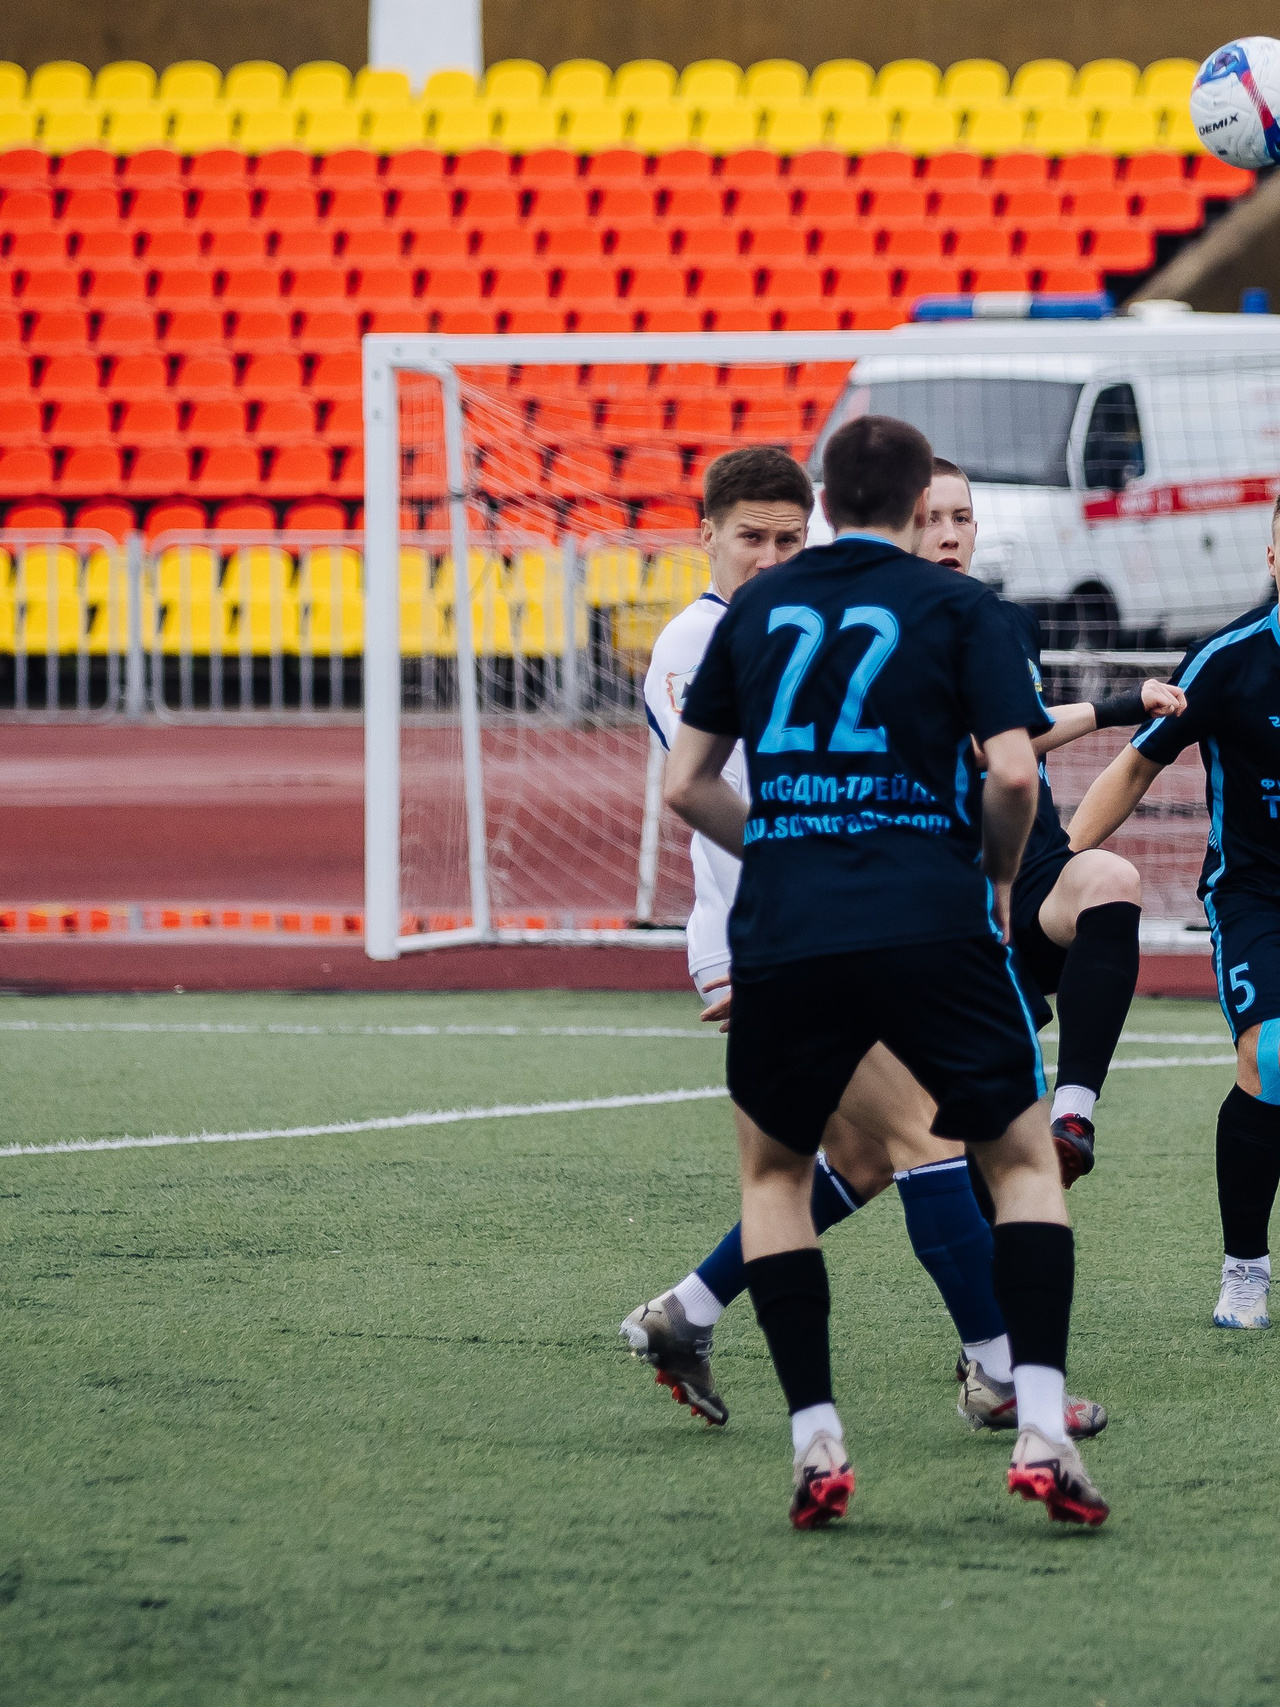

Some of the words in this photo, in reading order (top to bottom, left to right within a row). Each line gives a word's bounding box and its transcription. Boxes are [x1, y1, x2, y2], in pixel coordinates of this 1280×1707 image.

[1198, 112, 1239, 136] DEMIX
[756, 605, 899, 754] 22
[1229, 962, 1256, 1014] 5
